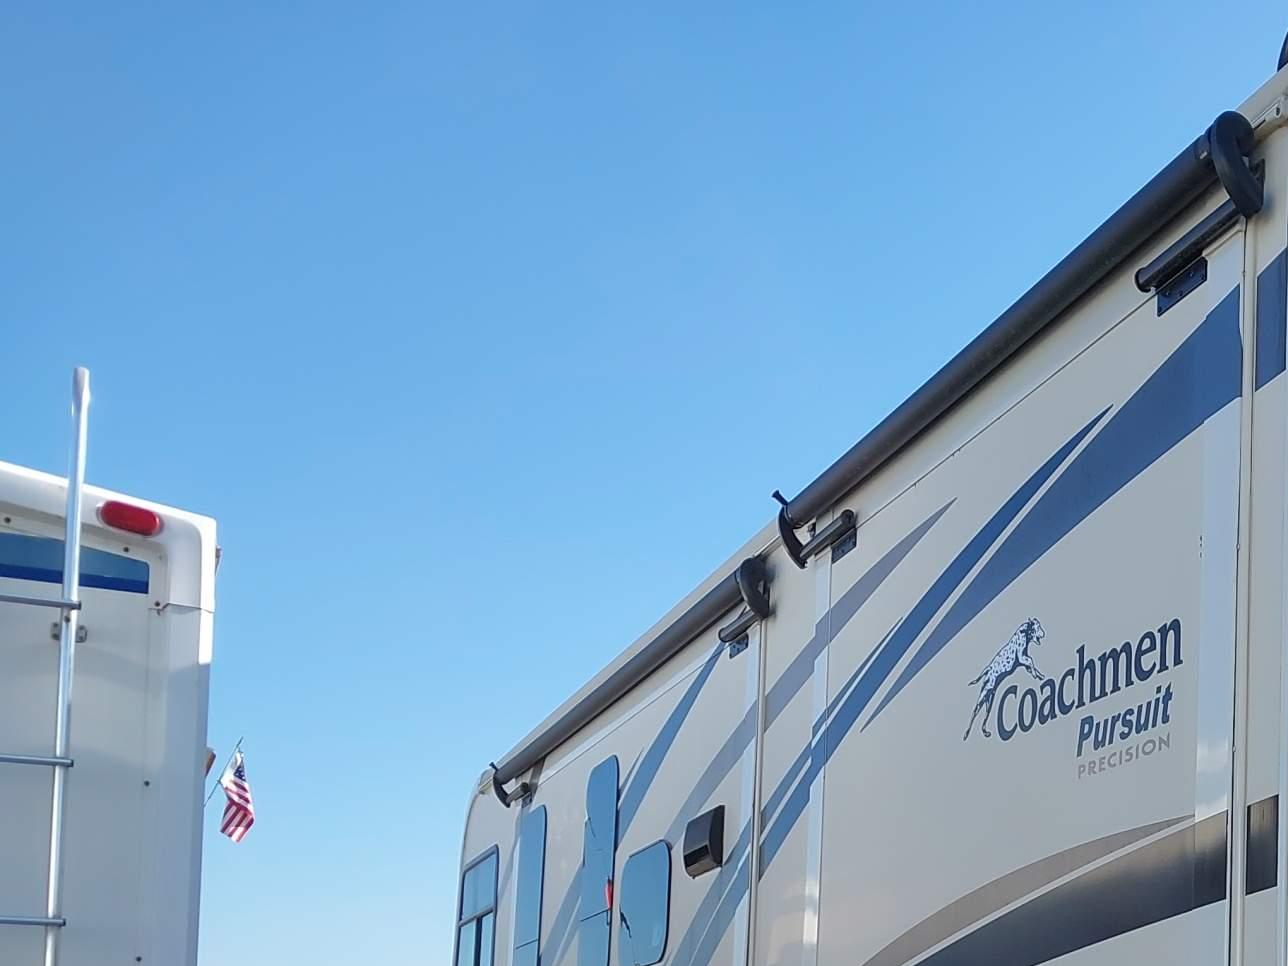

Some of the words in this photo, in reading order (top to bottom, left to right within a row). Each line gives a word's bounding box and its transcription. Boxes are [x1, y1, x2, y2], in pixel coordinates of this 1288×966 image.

[997, 618, 1184, 742] Coachmen
[1076, 682, 1173, 758] Pursuit
[1077, 732, 1171, 780] PRECISION
